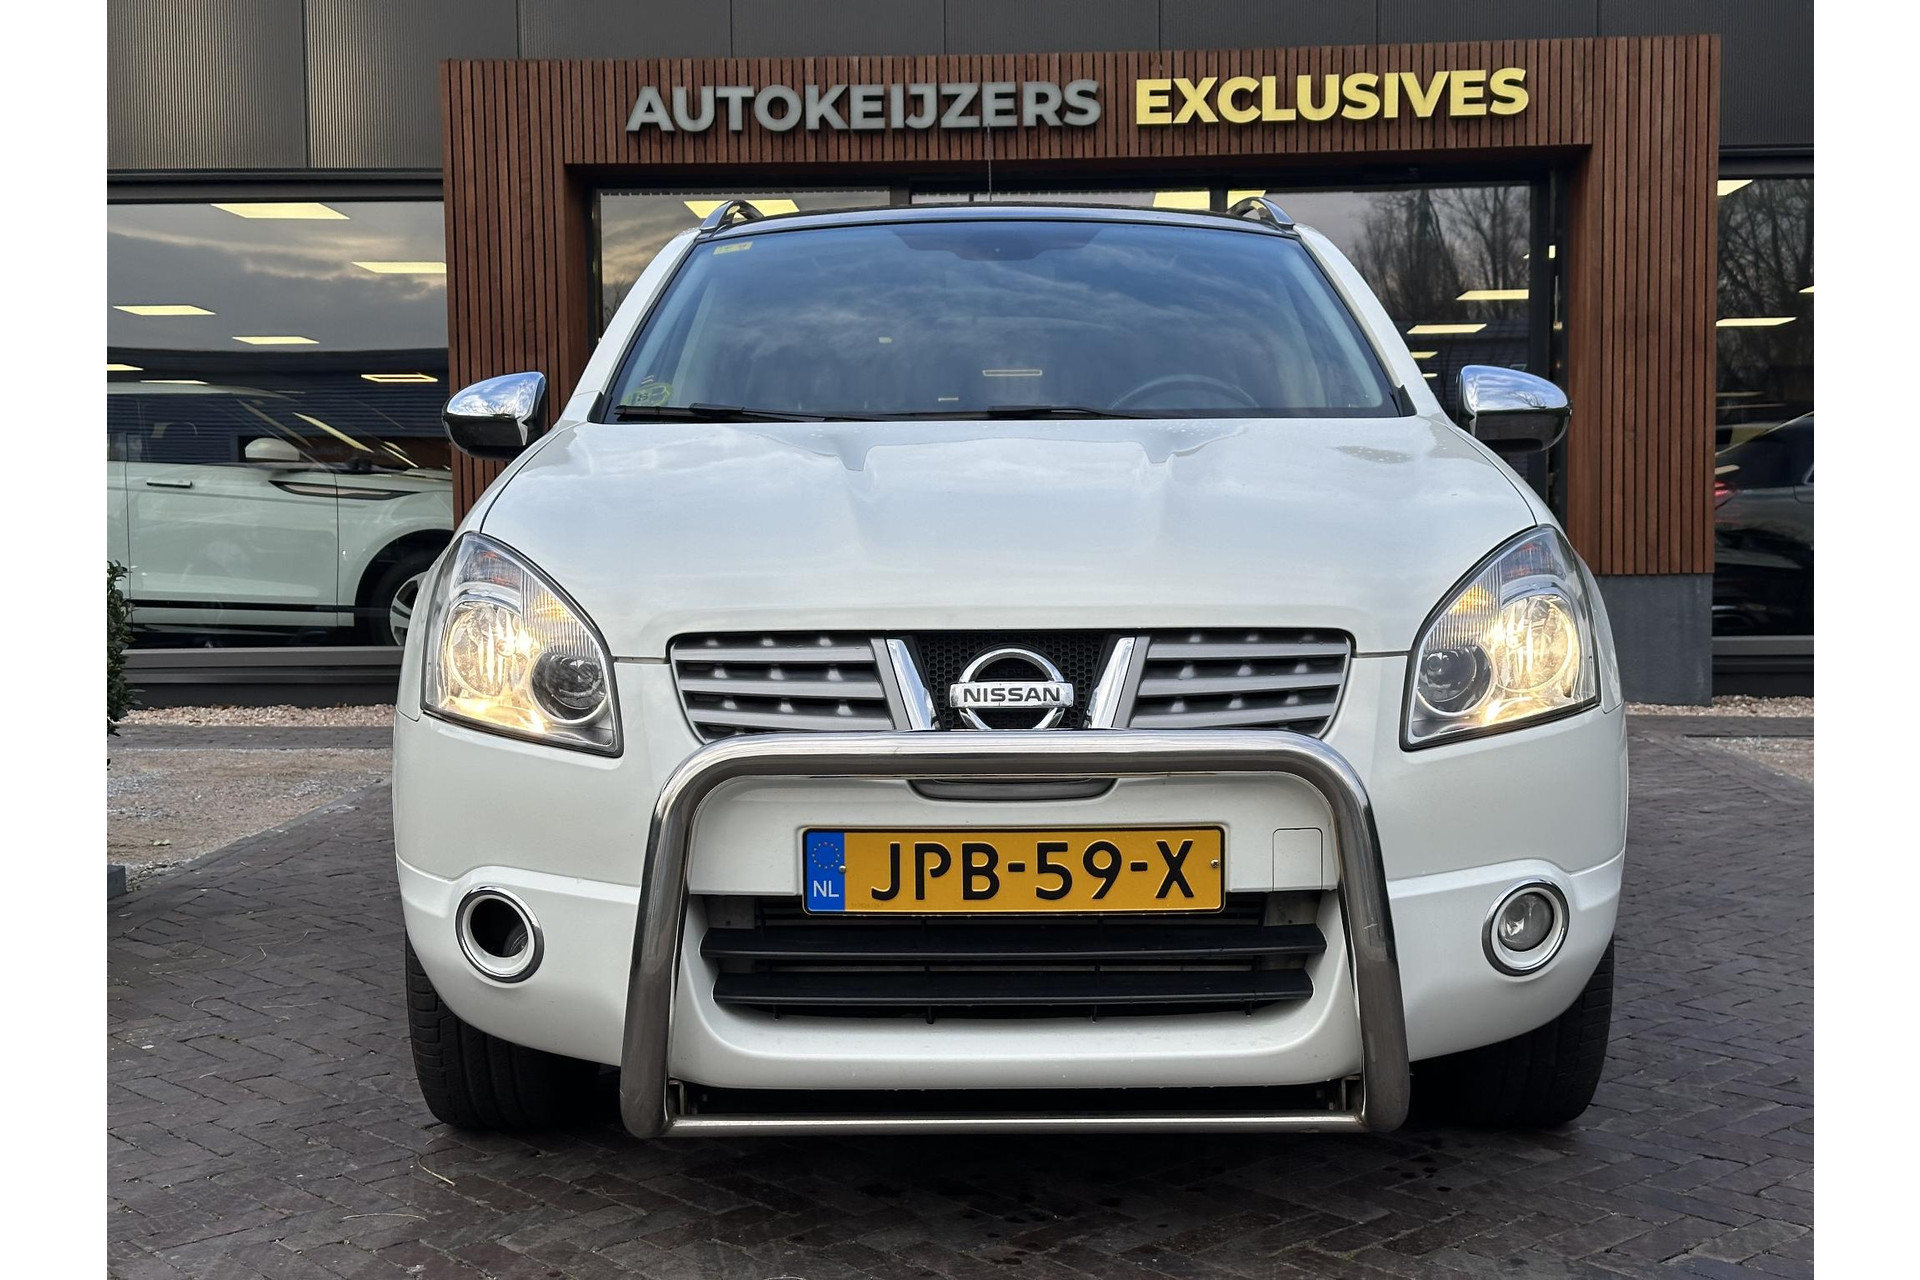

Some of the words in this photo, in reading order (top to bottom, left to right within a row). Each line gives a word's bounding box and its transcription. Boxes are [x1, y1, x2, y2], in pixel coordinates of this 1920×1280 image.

[625, 79, 1101, 132] AUTOKEIJZERS
[1136, 67, 1529, 125] EXCLUSIVES
[963, 687, 1061, 703] NISSAN
[813, 880, 840, 898] NL
[870, 839, 1195, 901] JPB-59-X
